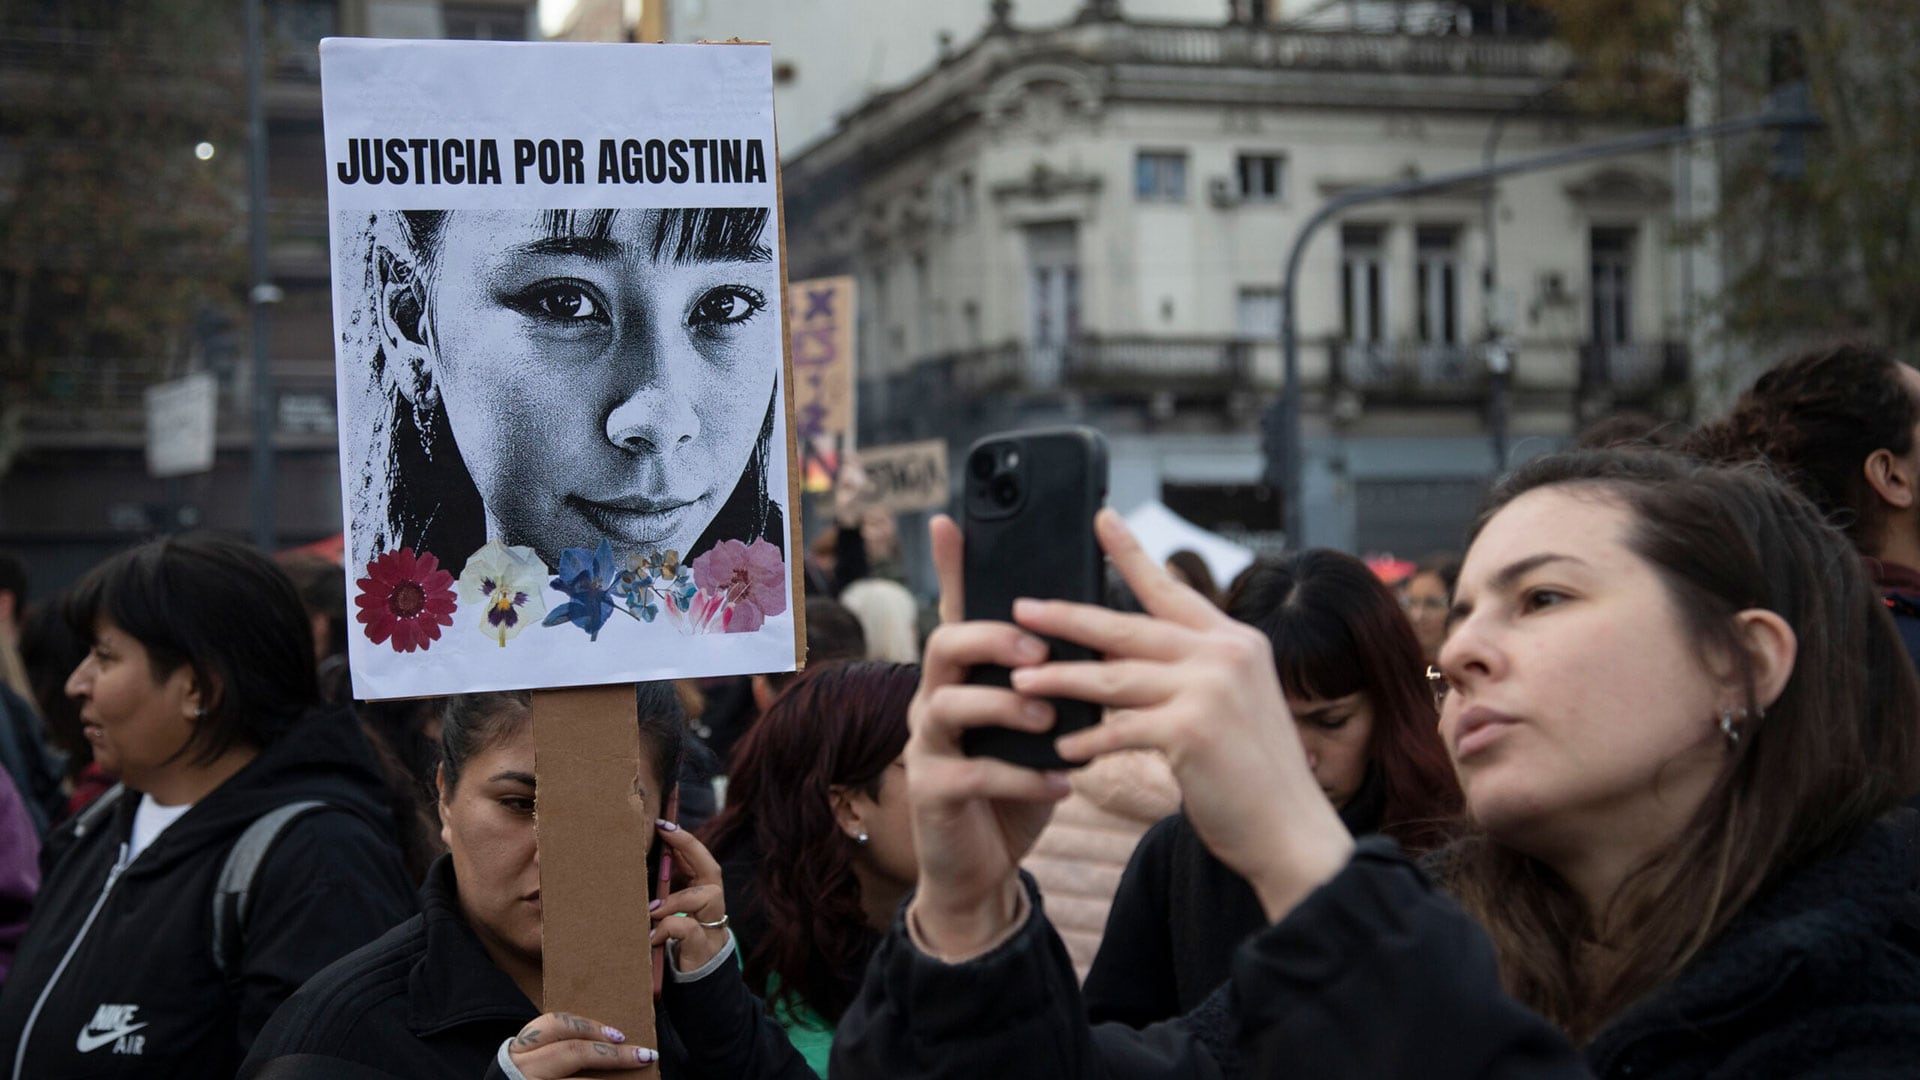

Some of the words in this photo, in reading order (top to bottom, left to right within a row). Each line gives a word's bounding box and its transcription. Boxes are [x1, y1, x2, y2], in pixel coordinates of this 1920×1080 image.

[337, 138, 502, 185] JUSTICIA
[514, 138, 585, 185] POR
[598, 138, 767, 184] AGOSTINA
[88, 1004, 139, 1031] NIKE
[112, 1034, 146, 1055] AIR
